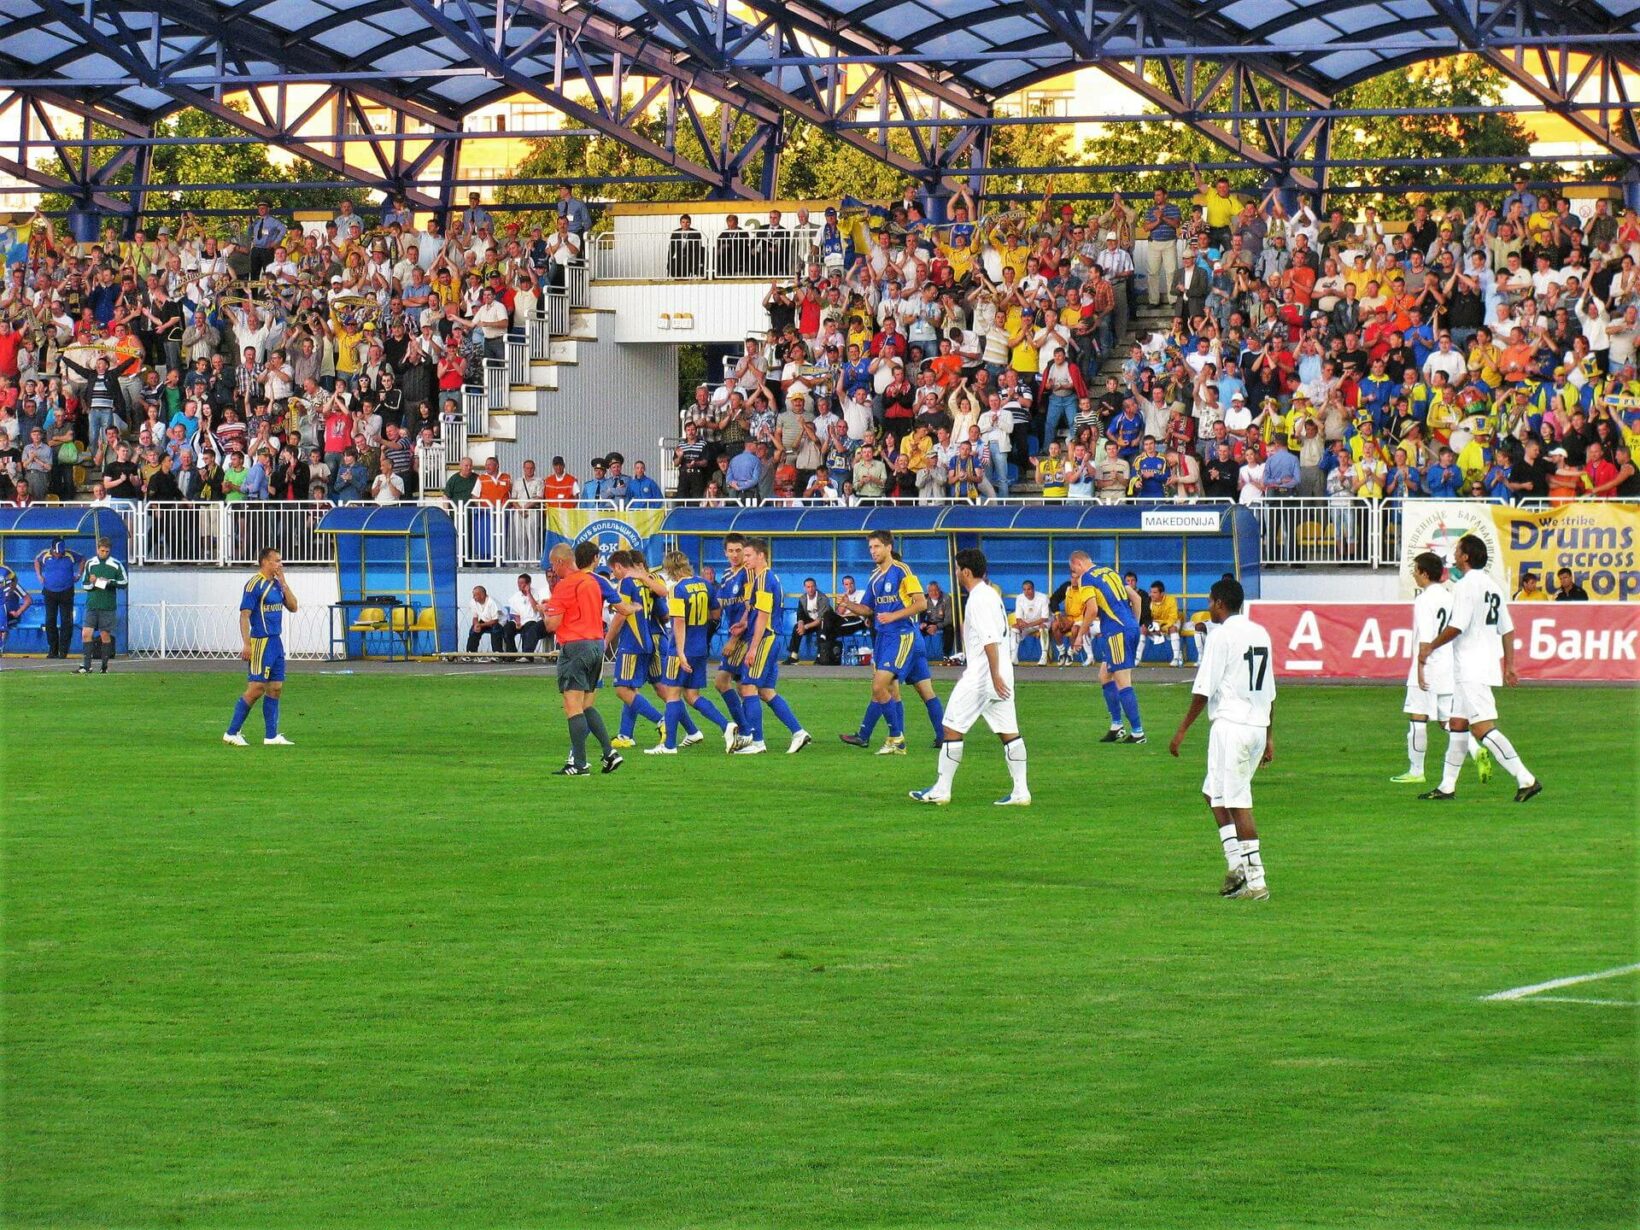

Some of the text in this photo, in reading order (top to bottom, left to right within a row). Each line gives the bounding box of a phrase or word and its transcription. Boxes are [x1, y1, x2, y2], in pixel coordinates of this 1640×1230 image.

[1145, 517, 1216, 527] MAKEDONIJA
[1539, 515, 1596, 527] We strike
[1510, 520, 1634, 550] Drums
[599, 543, 618, 553] ФК
[1557, 551, 1634, 568] across
[689, 591, 708, 626] 10
[1243, 645, 1269, 691] 17
